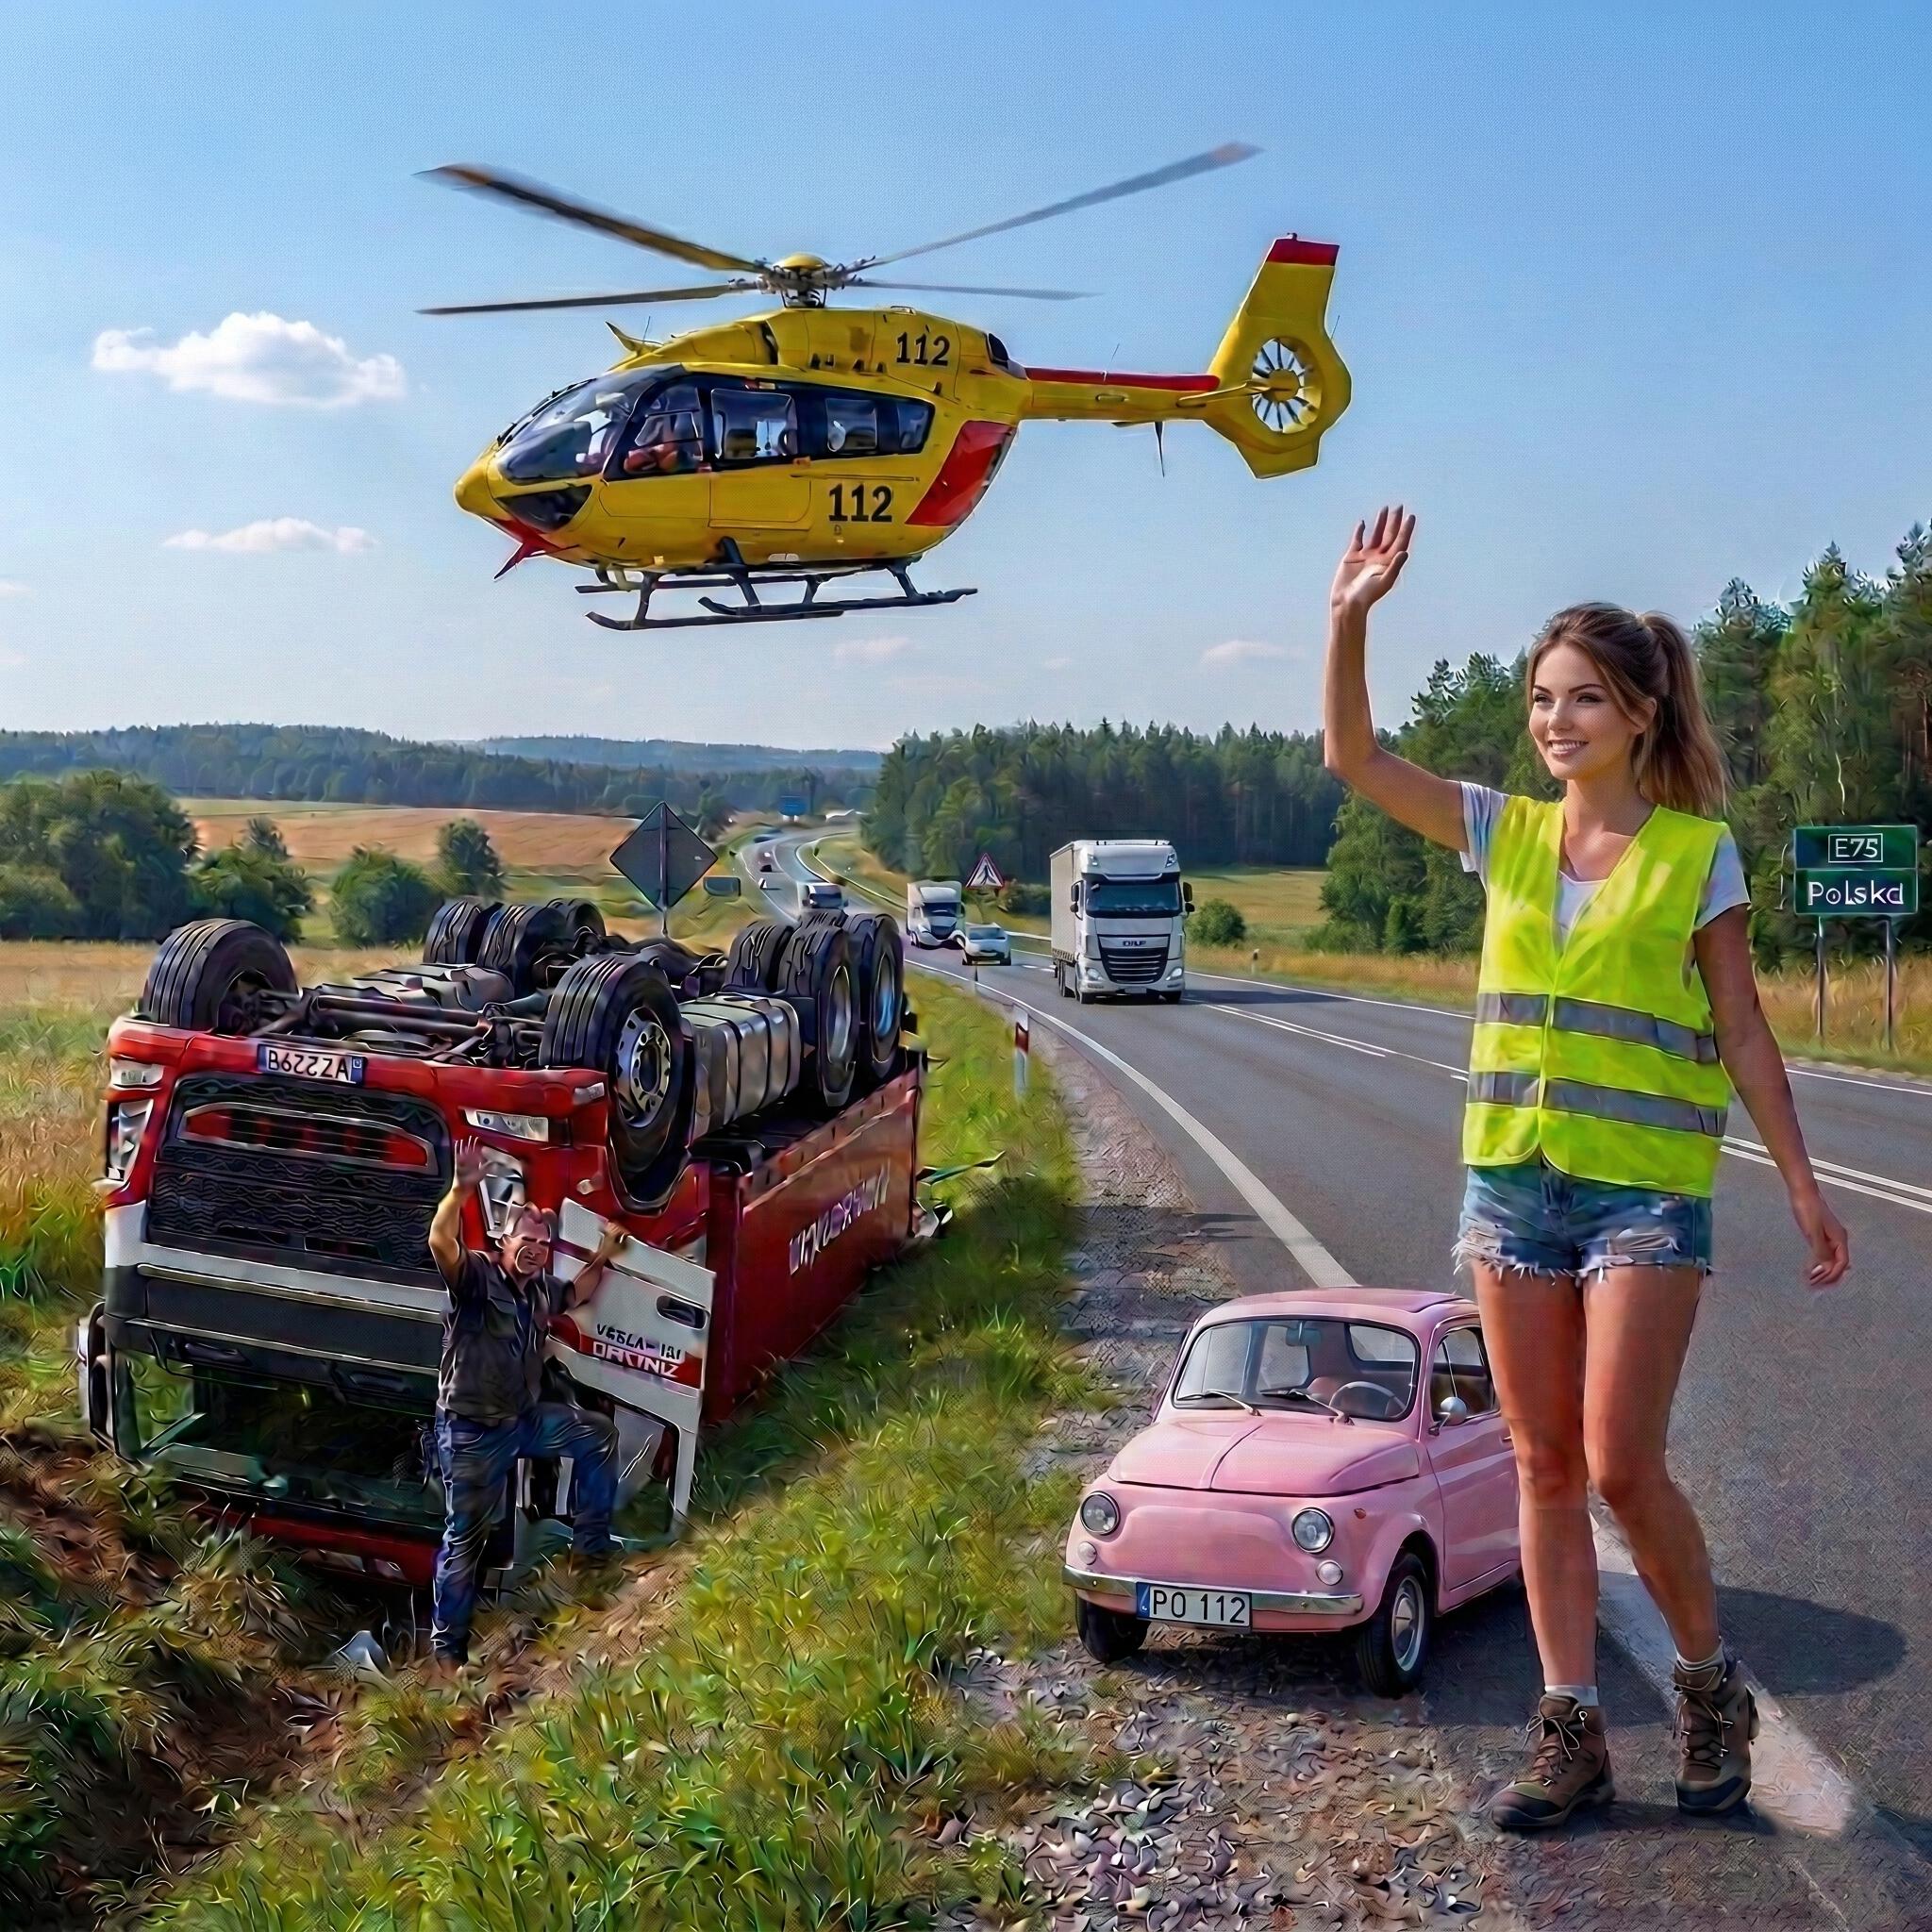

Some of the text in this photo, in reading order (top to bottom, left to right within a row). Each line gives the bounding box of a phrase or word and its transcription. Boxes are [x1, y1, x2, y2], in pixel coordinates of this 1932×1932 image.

[896, 332, 950, 366] 112
[828, 483, 892, 522] 112
[1835, 838, 1878, 858] E75
[1200, 1593, 1245, 1624] 112
